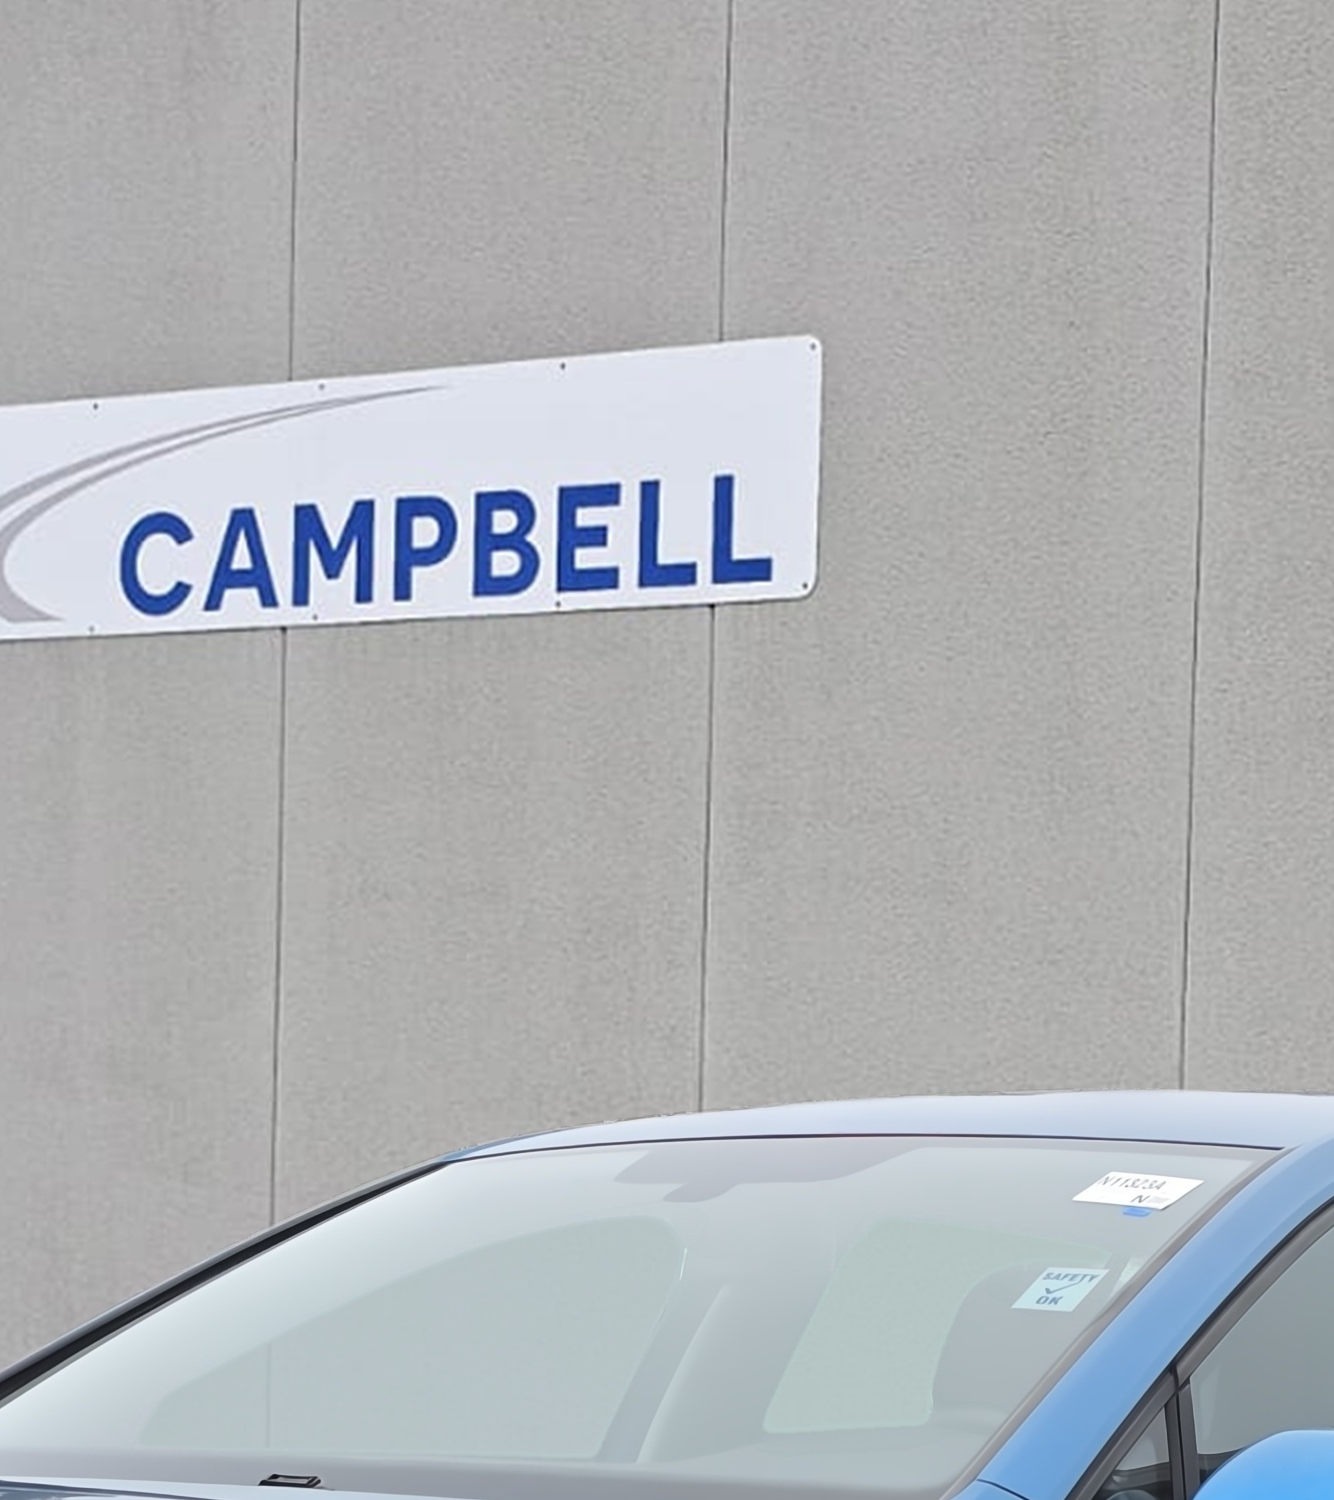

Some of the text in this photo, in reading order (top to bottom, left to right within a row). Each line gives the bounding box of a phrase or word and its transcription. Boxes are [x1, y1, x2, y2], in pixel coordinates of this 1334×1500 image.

[119, 474, 773, 616] CAMPBELL
[1043, 1272, 1101, 1282] SAFETY
[1035, 1295, 1064, 1305] OK
